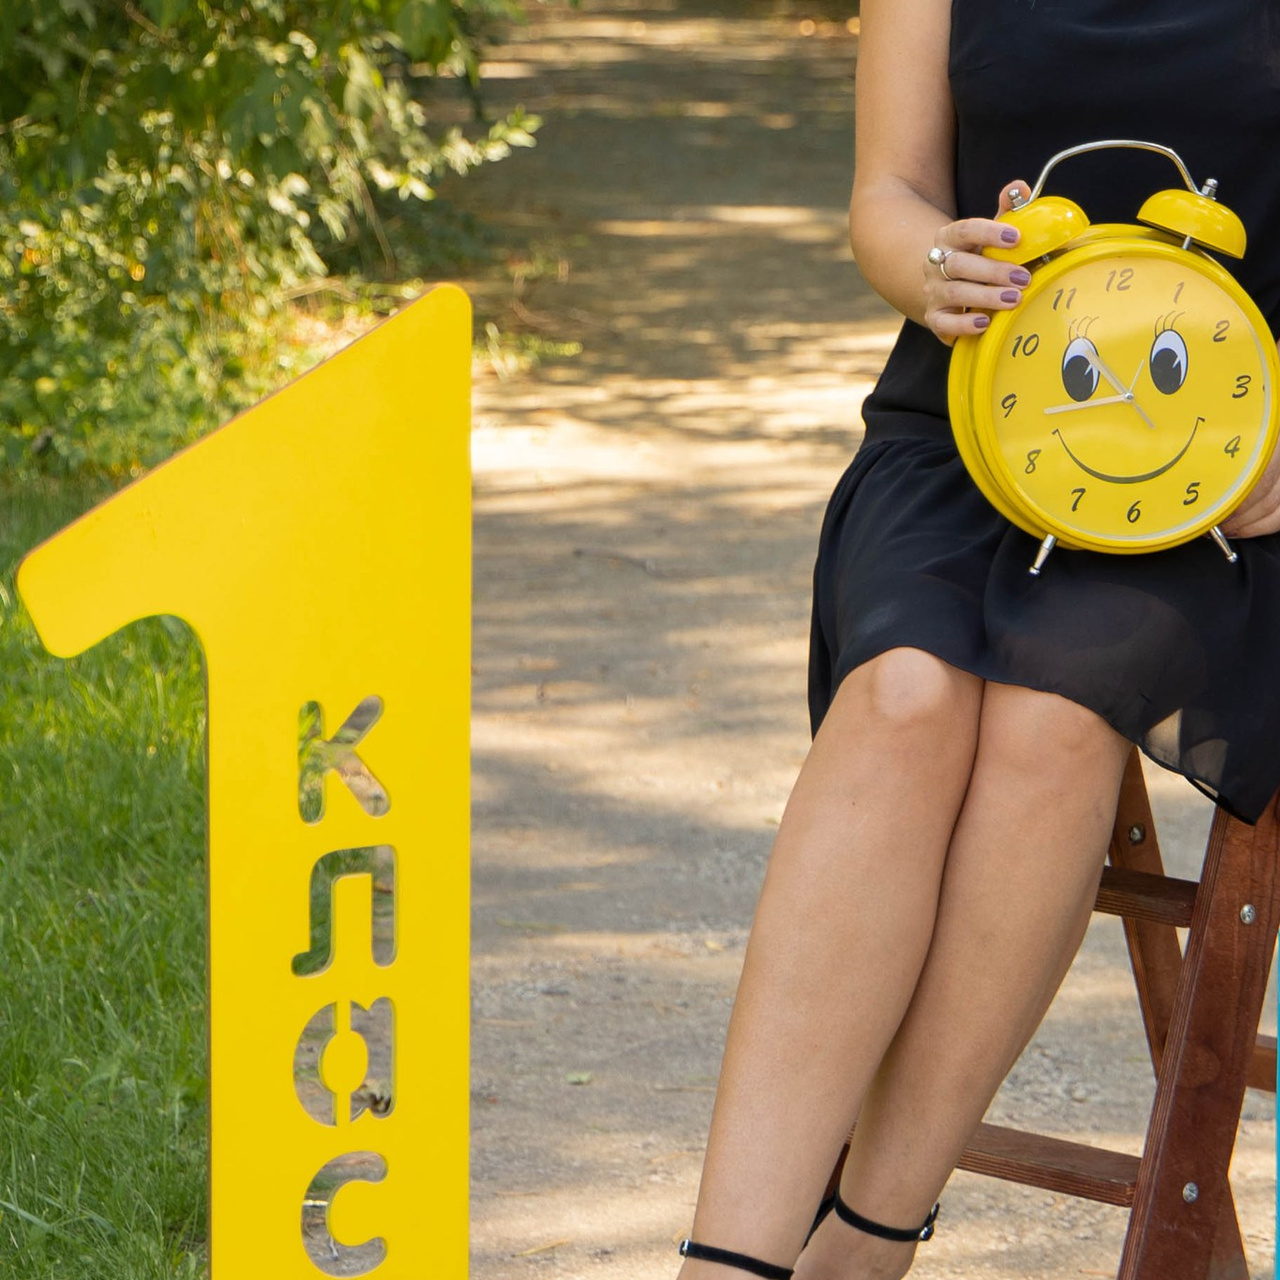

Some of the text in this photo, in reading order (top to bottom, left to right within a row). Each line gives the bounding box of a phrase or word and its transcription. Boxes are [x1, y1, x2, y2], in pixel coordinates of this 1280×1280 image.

[1105, 268, 1134, 292] 12
[1053, 288, 1077, 310] 11
[1173, 282, 1184, 303] 1
[1213, 320, 1230, 342] 2
[1012, 333, 1039, 357] 10
[1232, 375, 1252, 399] 3
[1001, 394, 1017, 418] 9
[1225, 435, 1241, 458] 4
[1024, 449, 1041, 474] 8
[1070, 488, 1086, 512] 7
[1183, 482, 1200, 506] 5
[1127, 500, 1141, 523] 6
[16, 281, 473, 1280] 1
